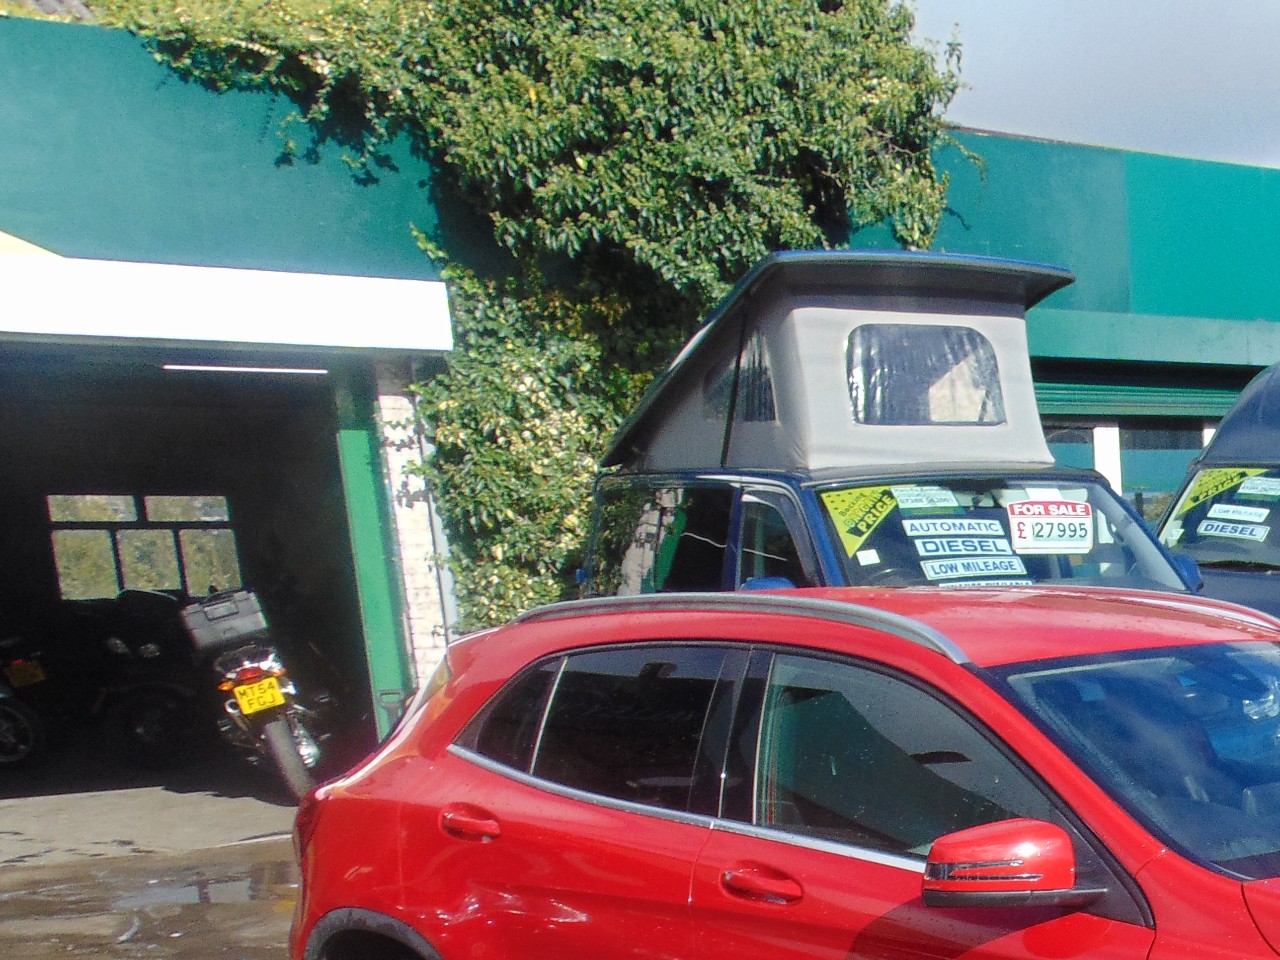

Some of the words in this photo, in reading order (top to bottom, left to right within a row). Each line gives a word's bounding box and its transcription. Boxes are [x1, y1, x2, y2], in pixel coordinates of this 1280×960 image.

[856, 494, 893, 533] PRICE
[1014, 504, 1048, 515] FOR
[1050, 504, 1086, 515] SALE
[909, 521, 999, 533] AUTOMATIC
[1203, 523, 1257, 536] DIESEL
[922, 540, 1007, 553] DIESEL
[931, 563, 959, 575] LOW
[962, 560, 1016, 573] MILEAGE
[238, 681, 275, 699] MT54
